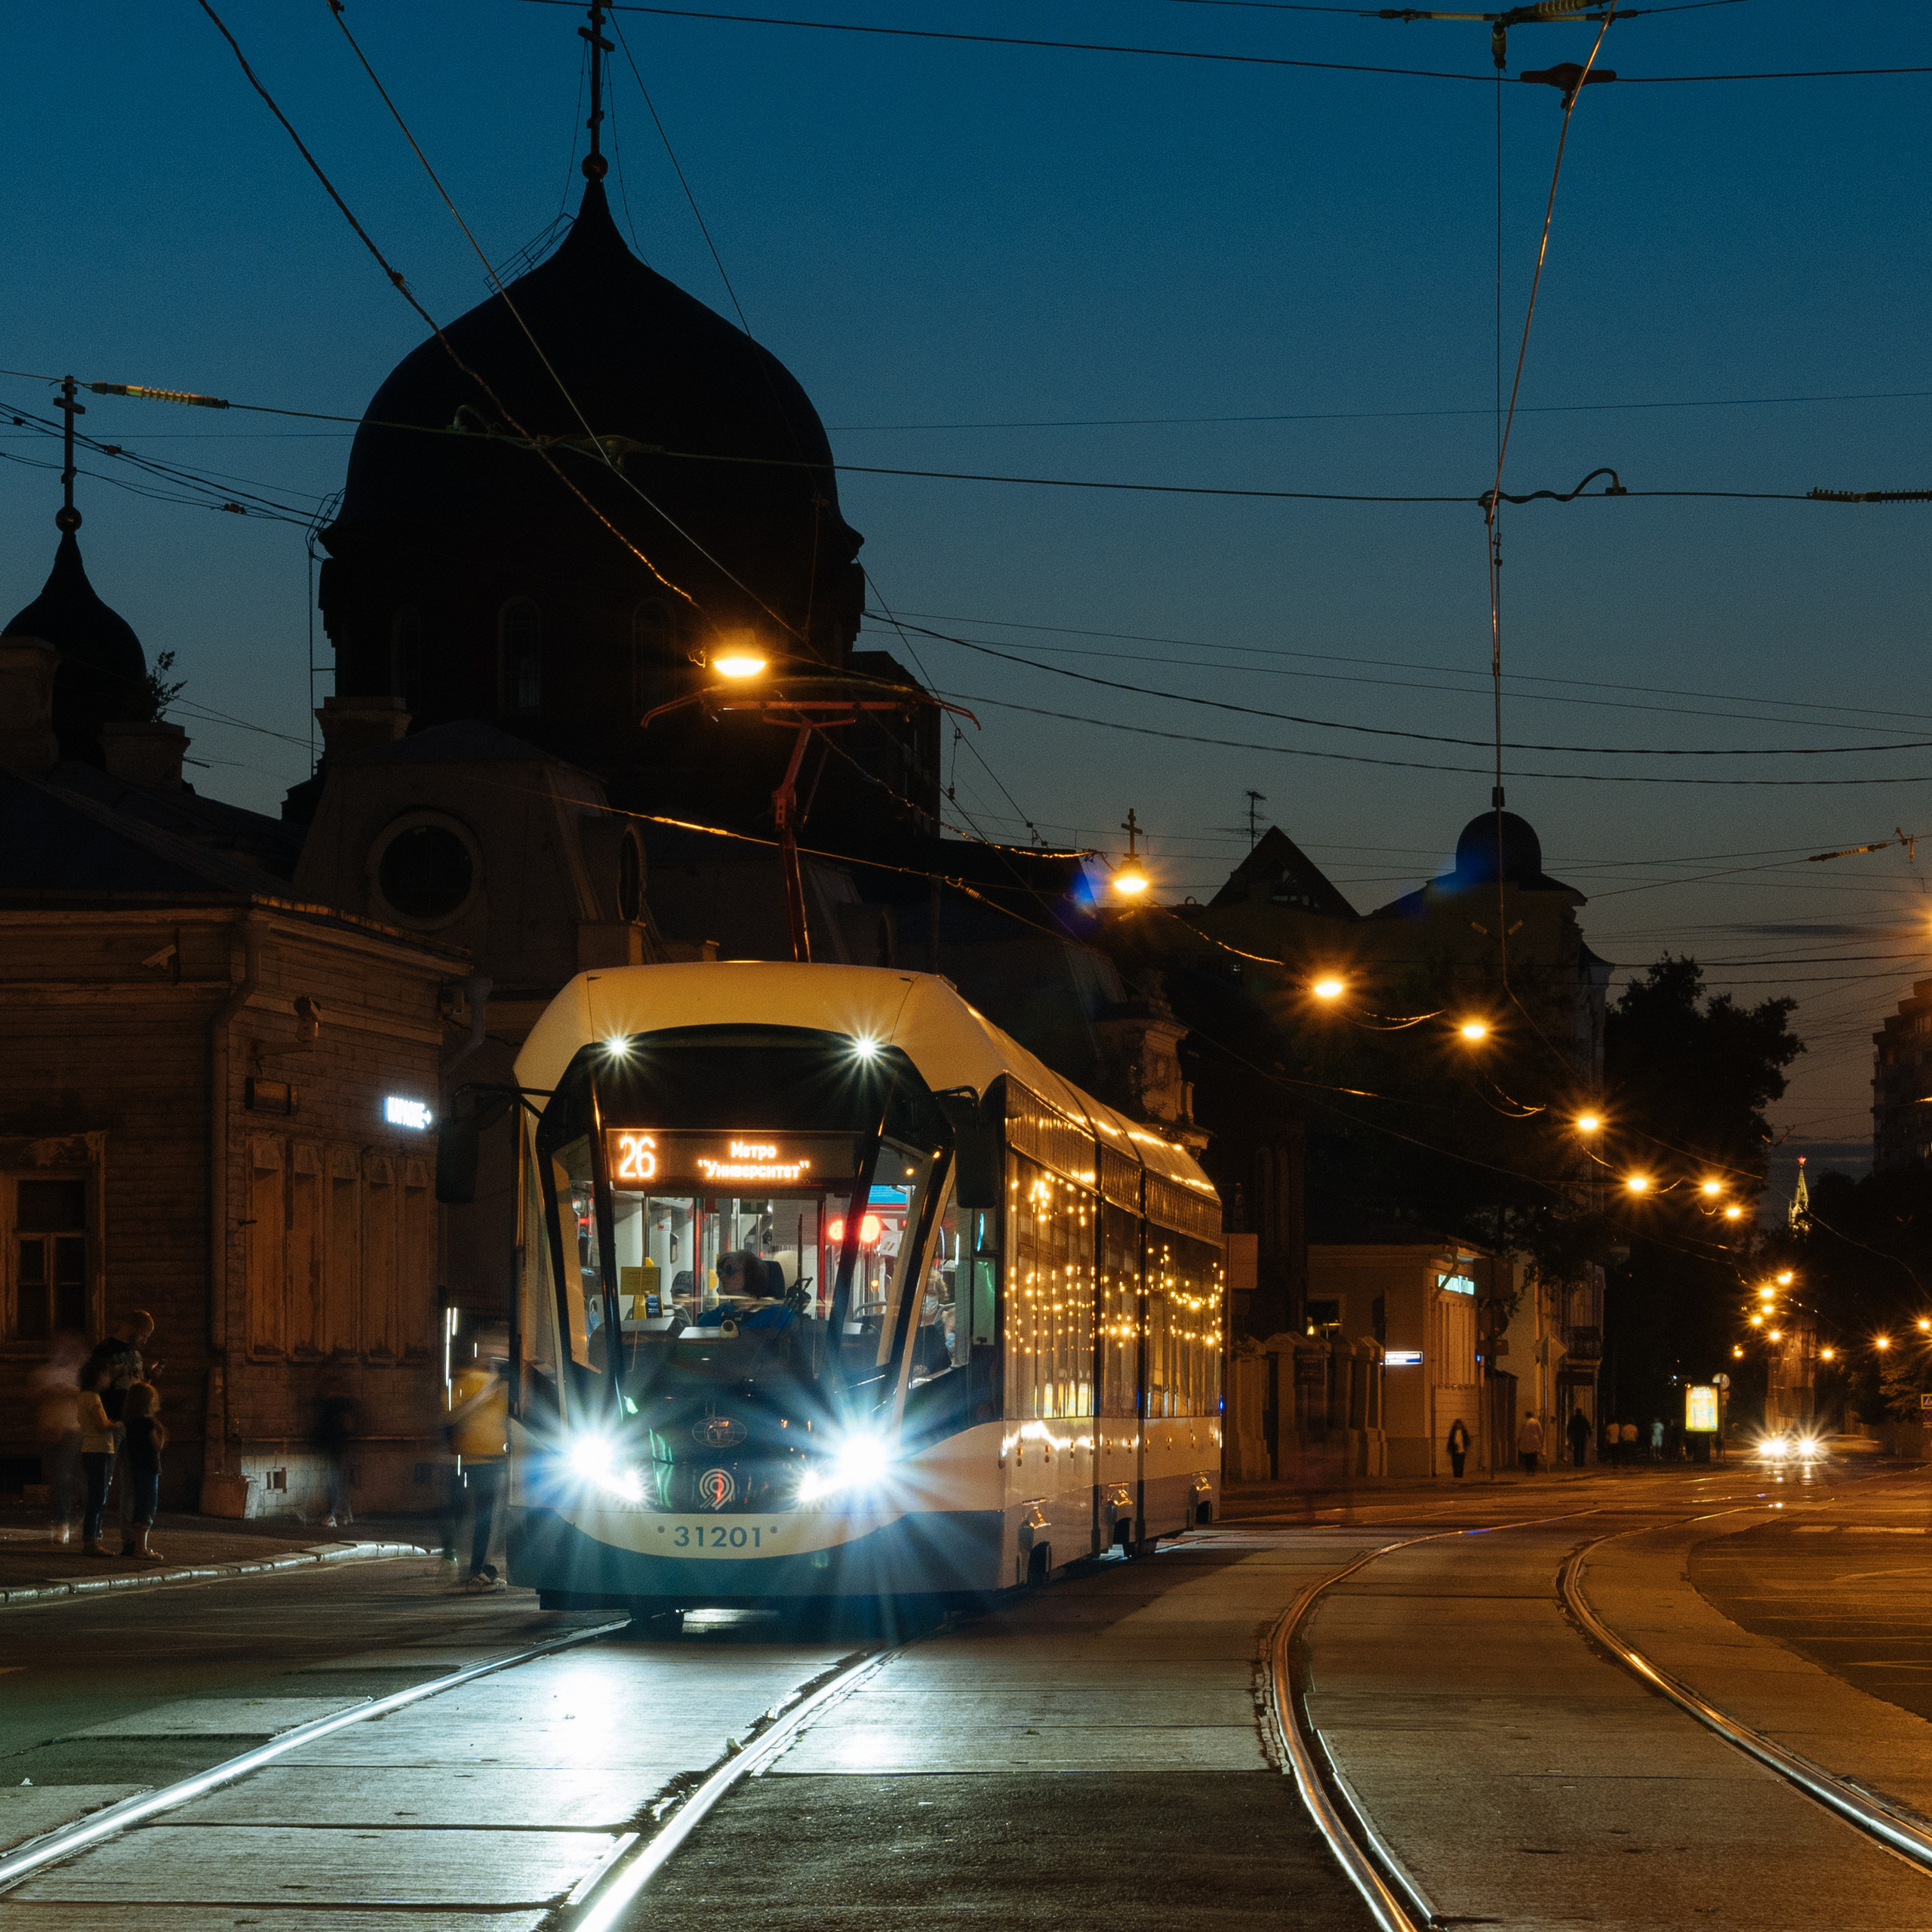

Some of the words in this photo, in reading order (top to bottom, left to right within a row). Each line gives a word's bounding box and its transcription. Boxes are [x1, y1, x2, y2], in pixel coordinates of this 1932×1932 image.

[620, 1136, 656, 1177] 26
[731, 1141, 777, 1161] Метро
[698, 1159, 810, 1179] "Университет"
[674, 1526, 760, 1547] 31201
